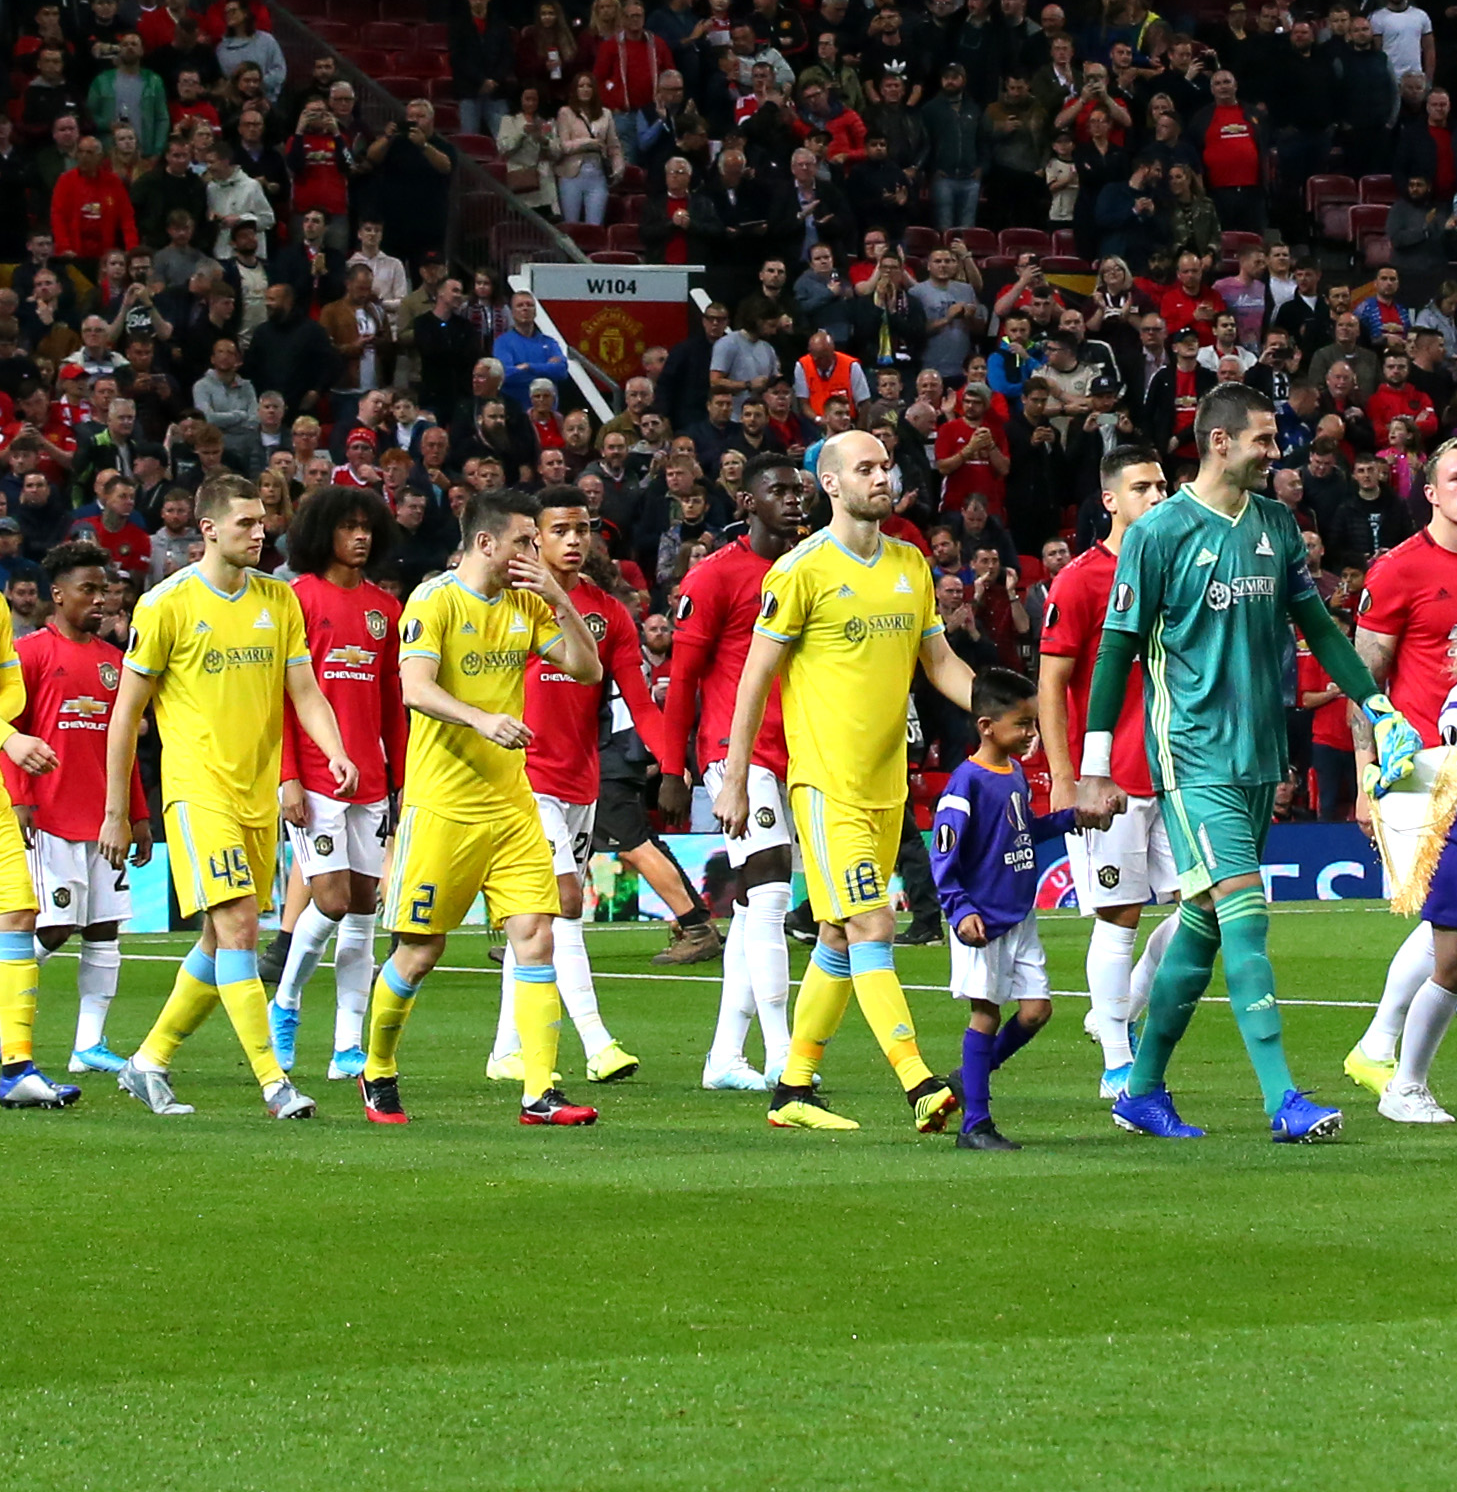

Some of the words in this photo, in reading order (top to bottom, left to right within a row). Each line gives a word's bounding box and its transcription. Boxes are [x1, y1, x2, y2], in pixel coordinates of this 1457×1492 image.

[586, 278, 637, 295] W104
[226, 646, 275, 663] SAMRUK
[1004, 847, 1034, 865] EURO
[209, 846, 252, 889] 45
[1013, 860, 1035, 873] LEAG
[845, 861, 880, 904] 18
[410, 883, 437, 925] 2
